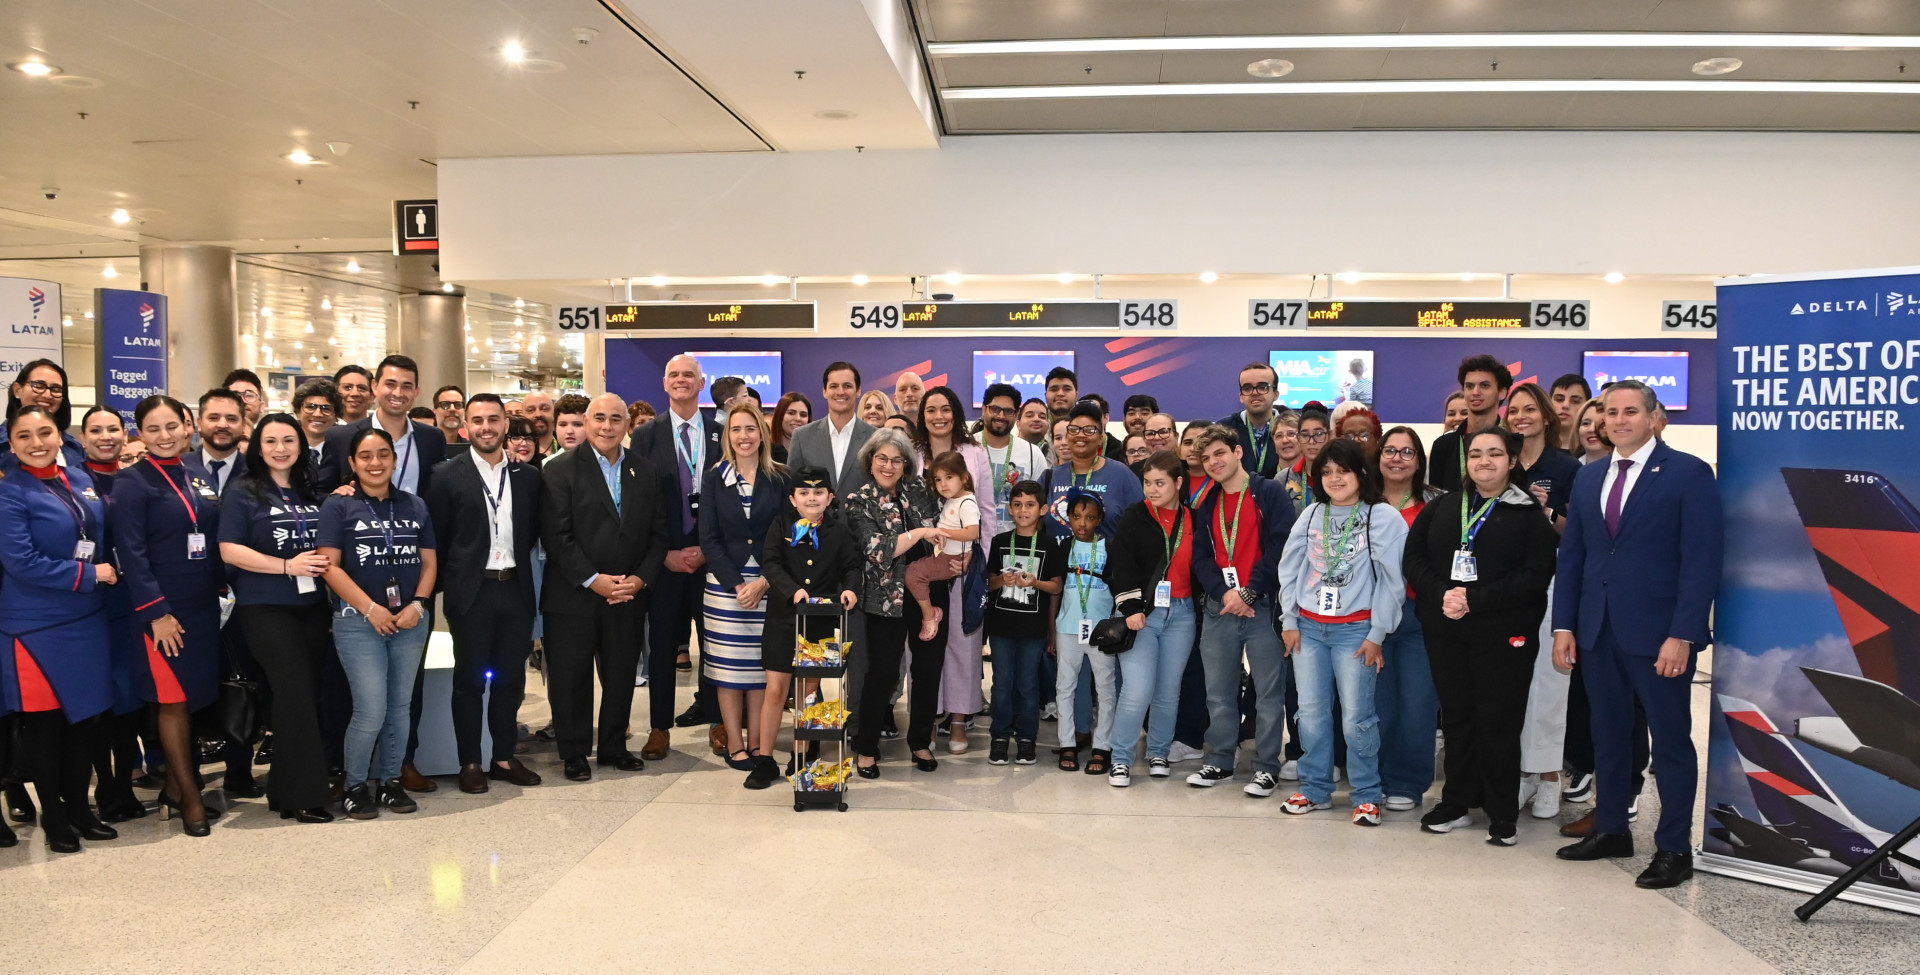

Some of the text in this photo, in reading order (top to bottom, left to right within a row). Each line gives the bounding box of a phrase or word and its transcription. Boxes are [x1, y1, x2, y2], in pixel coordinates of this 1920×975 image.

[1809, 300, 1867, 313] DELTA
[558, 307, 600, 330] 551
[606, 314, 635, 323] LATAM
[708, 313, 738, 322] LATAM
[850, 305, 899, 329] 549
[903, 312, 933, 321] LATAM
[1009, 311, 1040, 320] LATAM
[1123, 303, 1175, 327] 548
[1253, 303, 1302, 326] 547
[1308, 310, 1339, 320] LATAM
[1418, 311, 1449, 320] LATAM
[1535, 303, 1587, 328] 546
[1665, 304, 1717, 329] 545
[1418, 318, 1522, 328] SPECIAL ASSISTANCE
[12, 324, 54, 336] LATAM
[124, 336, 161, 348] LATAM
[1732, 340, 1920, 374] THE BEST OF
[110, 369, 148, 384] Tagged
[110, 384, 153, 399] Baggage
[1732, 378, 1789, 407] THE
[1732, 410, 1905, 431] NOW TOGETHER.
[1844, 473, 1875, 485] 3416
[370, 519, 421, 530] DELTA
